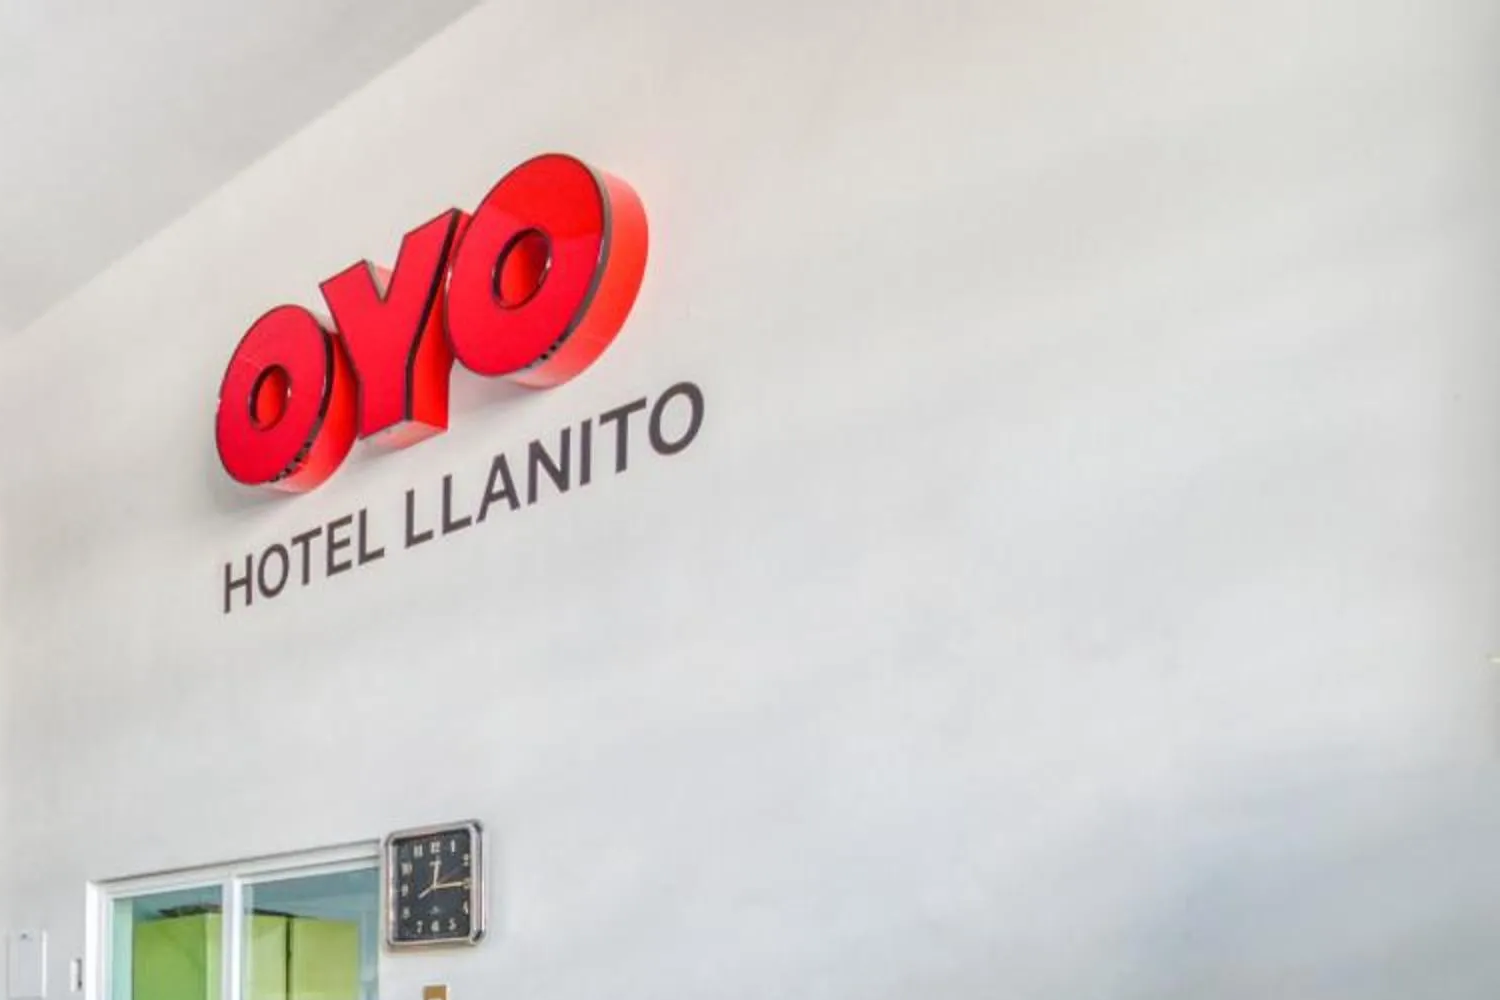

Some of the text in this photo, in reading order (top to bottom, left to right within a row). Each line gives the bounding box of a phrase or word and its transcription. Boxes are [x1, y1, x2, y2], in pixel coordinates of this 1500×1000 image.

[215, 153, 649, 494] OYO
[224, 381, 705, 614] HOTEL LLANITO
